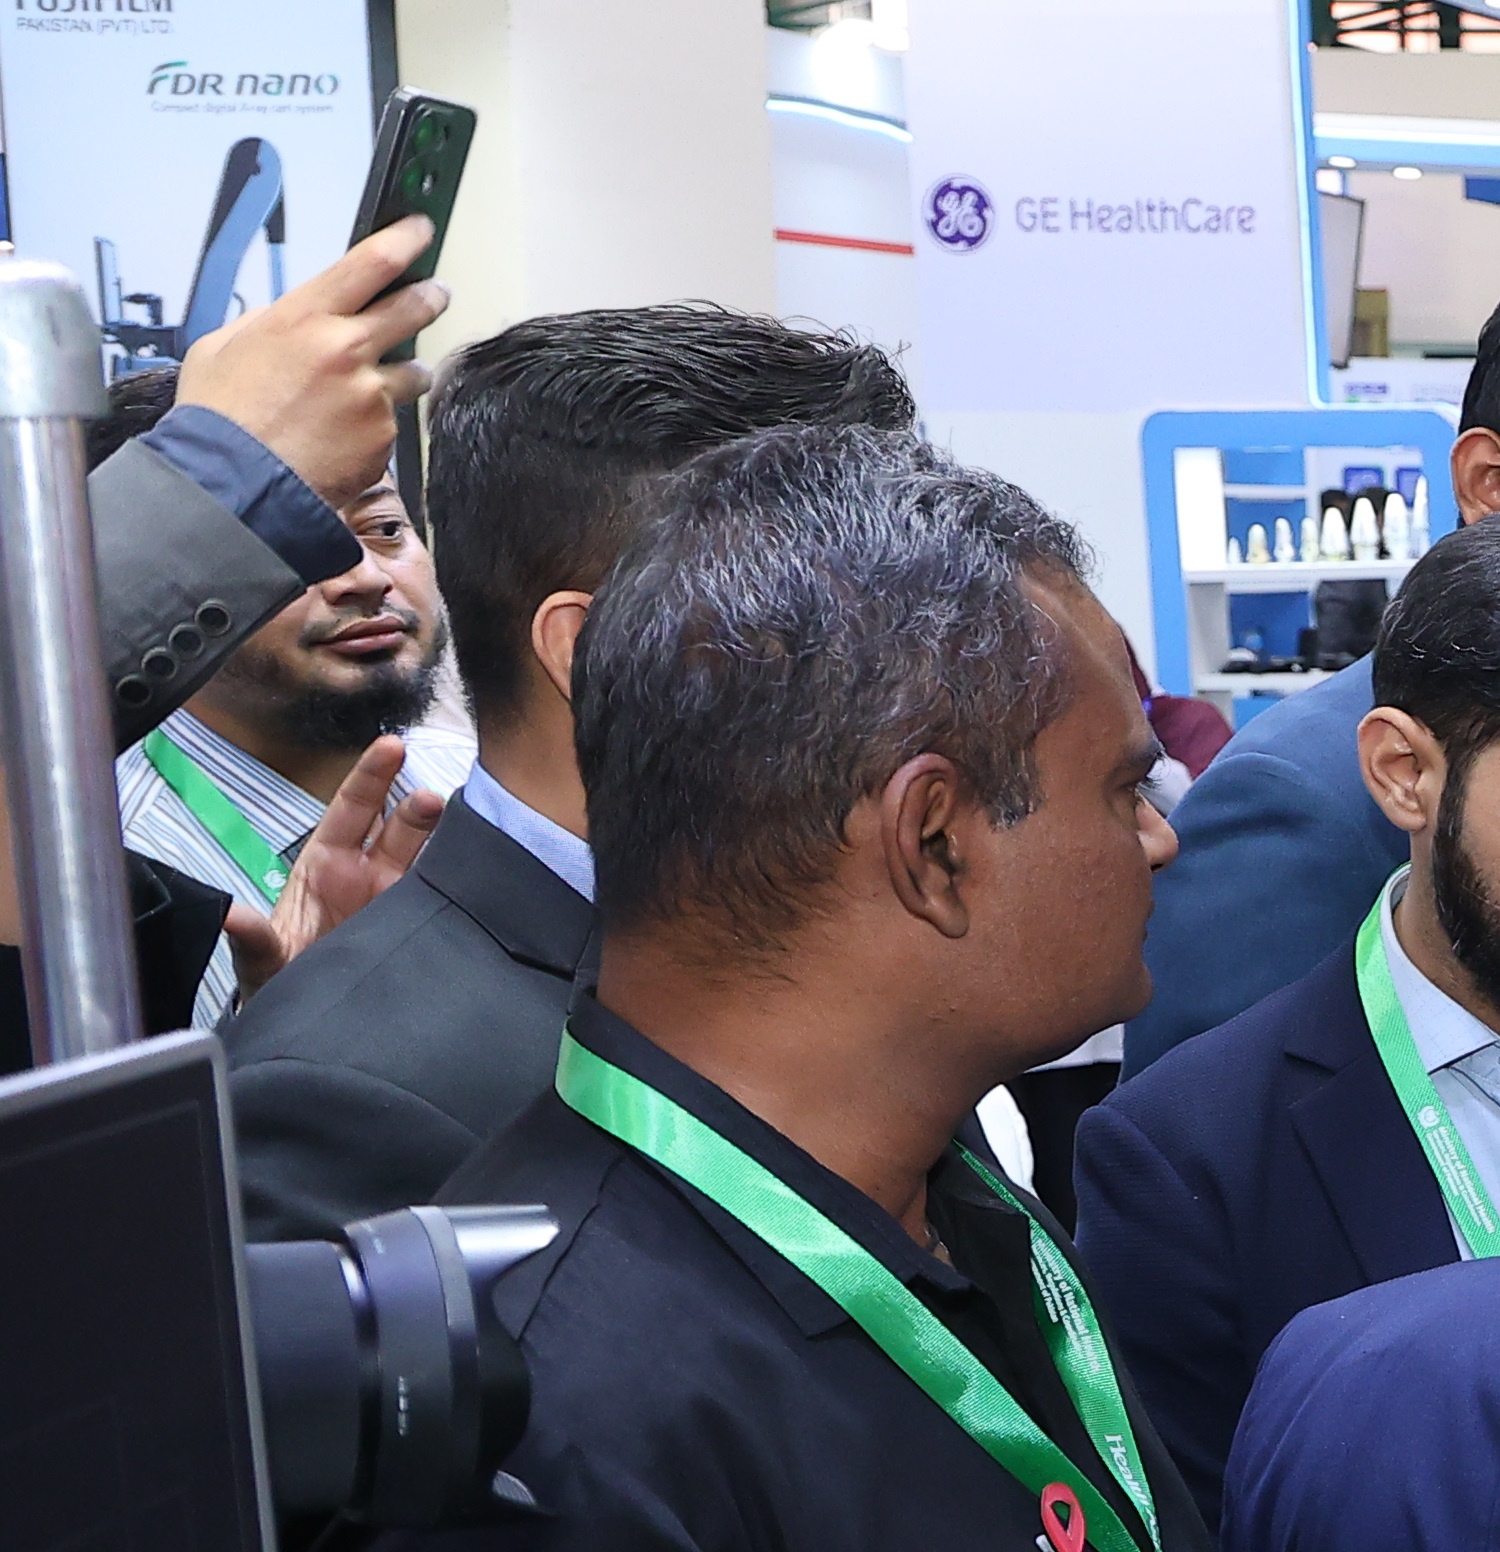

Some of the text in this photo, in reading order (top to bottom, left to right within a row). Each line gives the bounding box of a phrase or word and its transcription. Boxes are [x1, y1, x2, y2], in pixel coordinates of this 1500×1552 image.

[17, 17, 94, 33] PAKISTAN
[235, 73, 340, 97] nano
[1015, 197, 1257, 234] GE HealthCare
[1063, 1291, 1090, 1336] National
